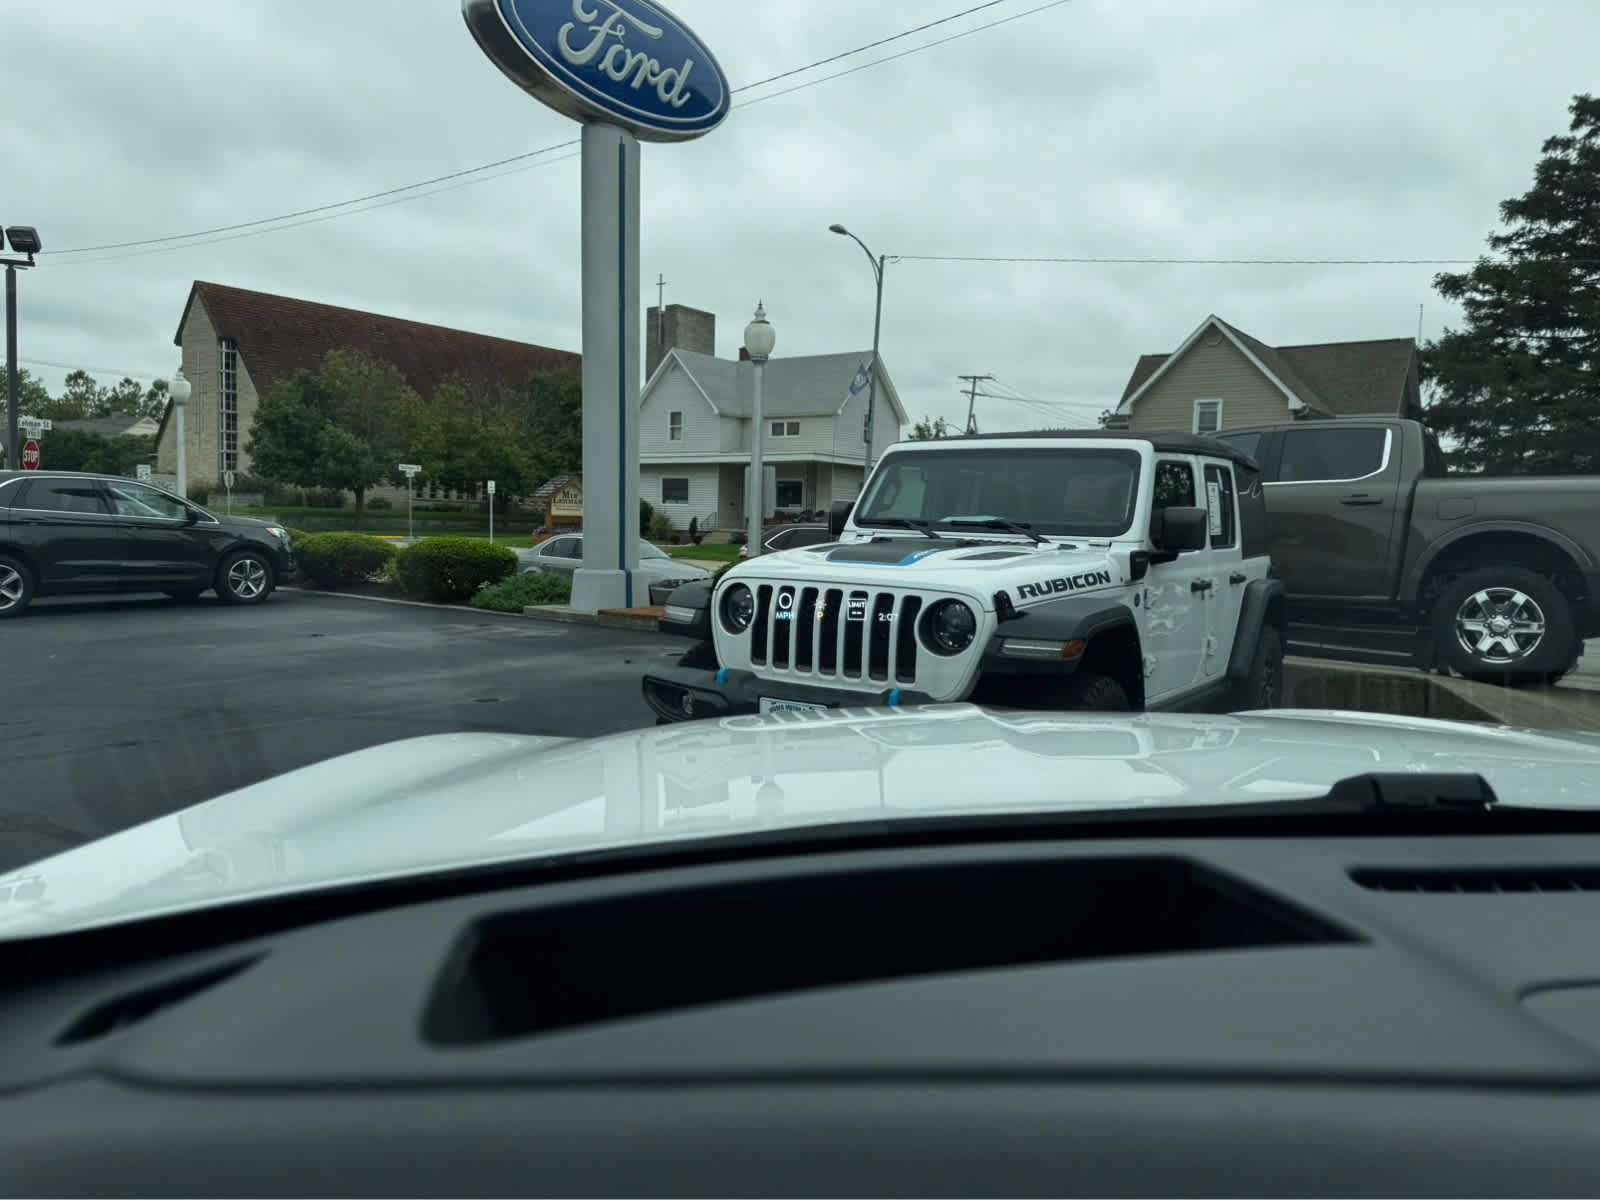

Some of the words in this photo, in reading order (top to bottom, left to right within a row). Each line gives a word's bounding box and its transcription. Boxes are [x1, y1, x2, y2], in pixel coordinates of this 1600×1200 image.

[558, 0, 693, 107] Ford
[24, 450, 39, 462] STOP
[1016, 570, 1111, 600] RUBICON
[775, 611, 794, 620] MPH
[878, 612, 898, 622] 2:07
